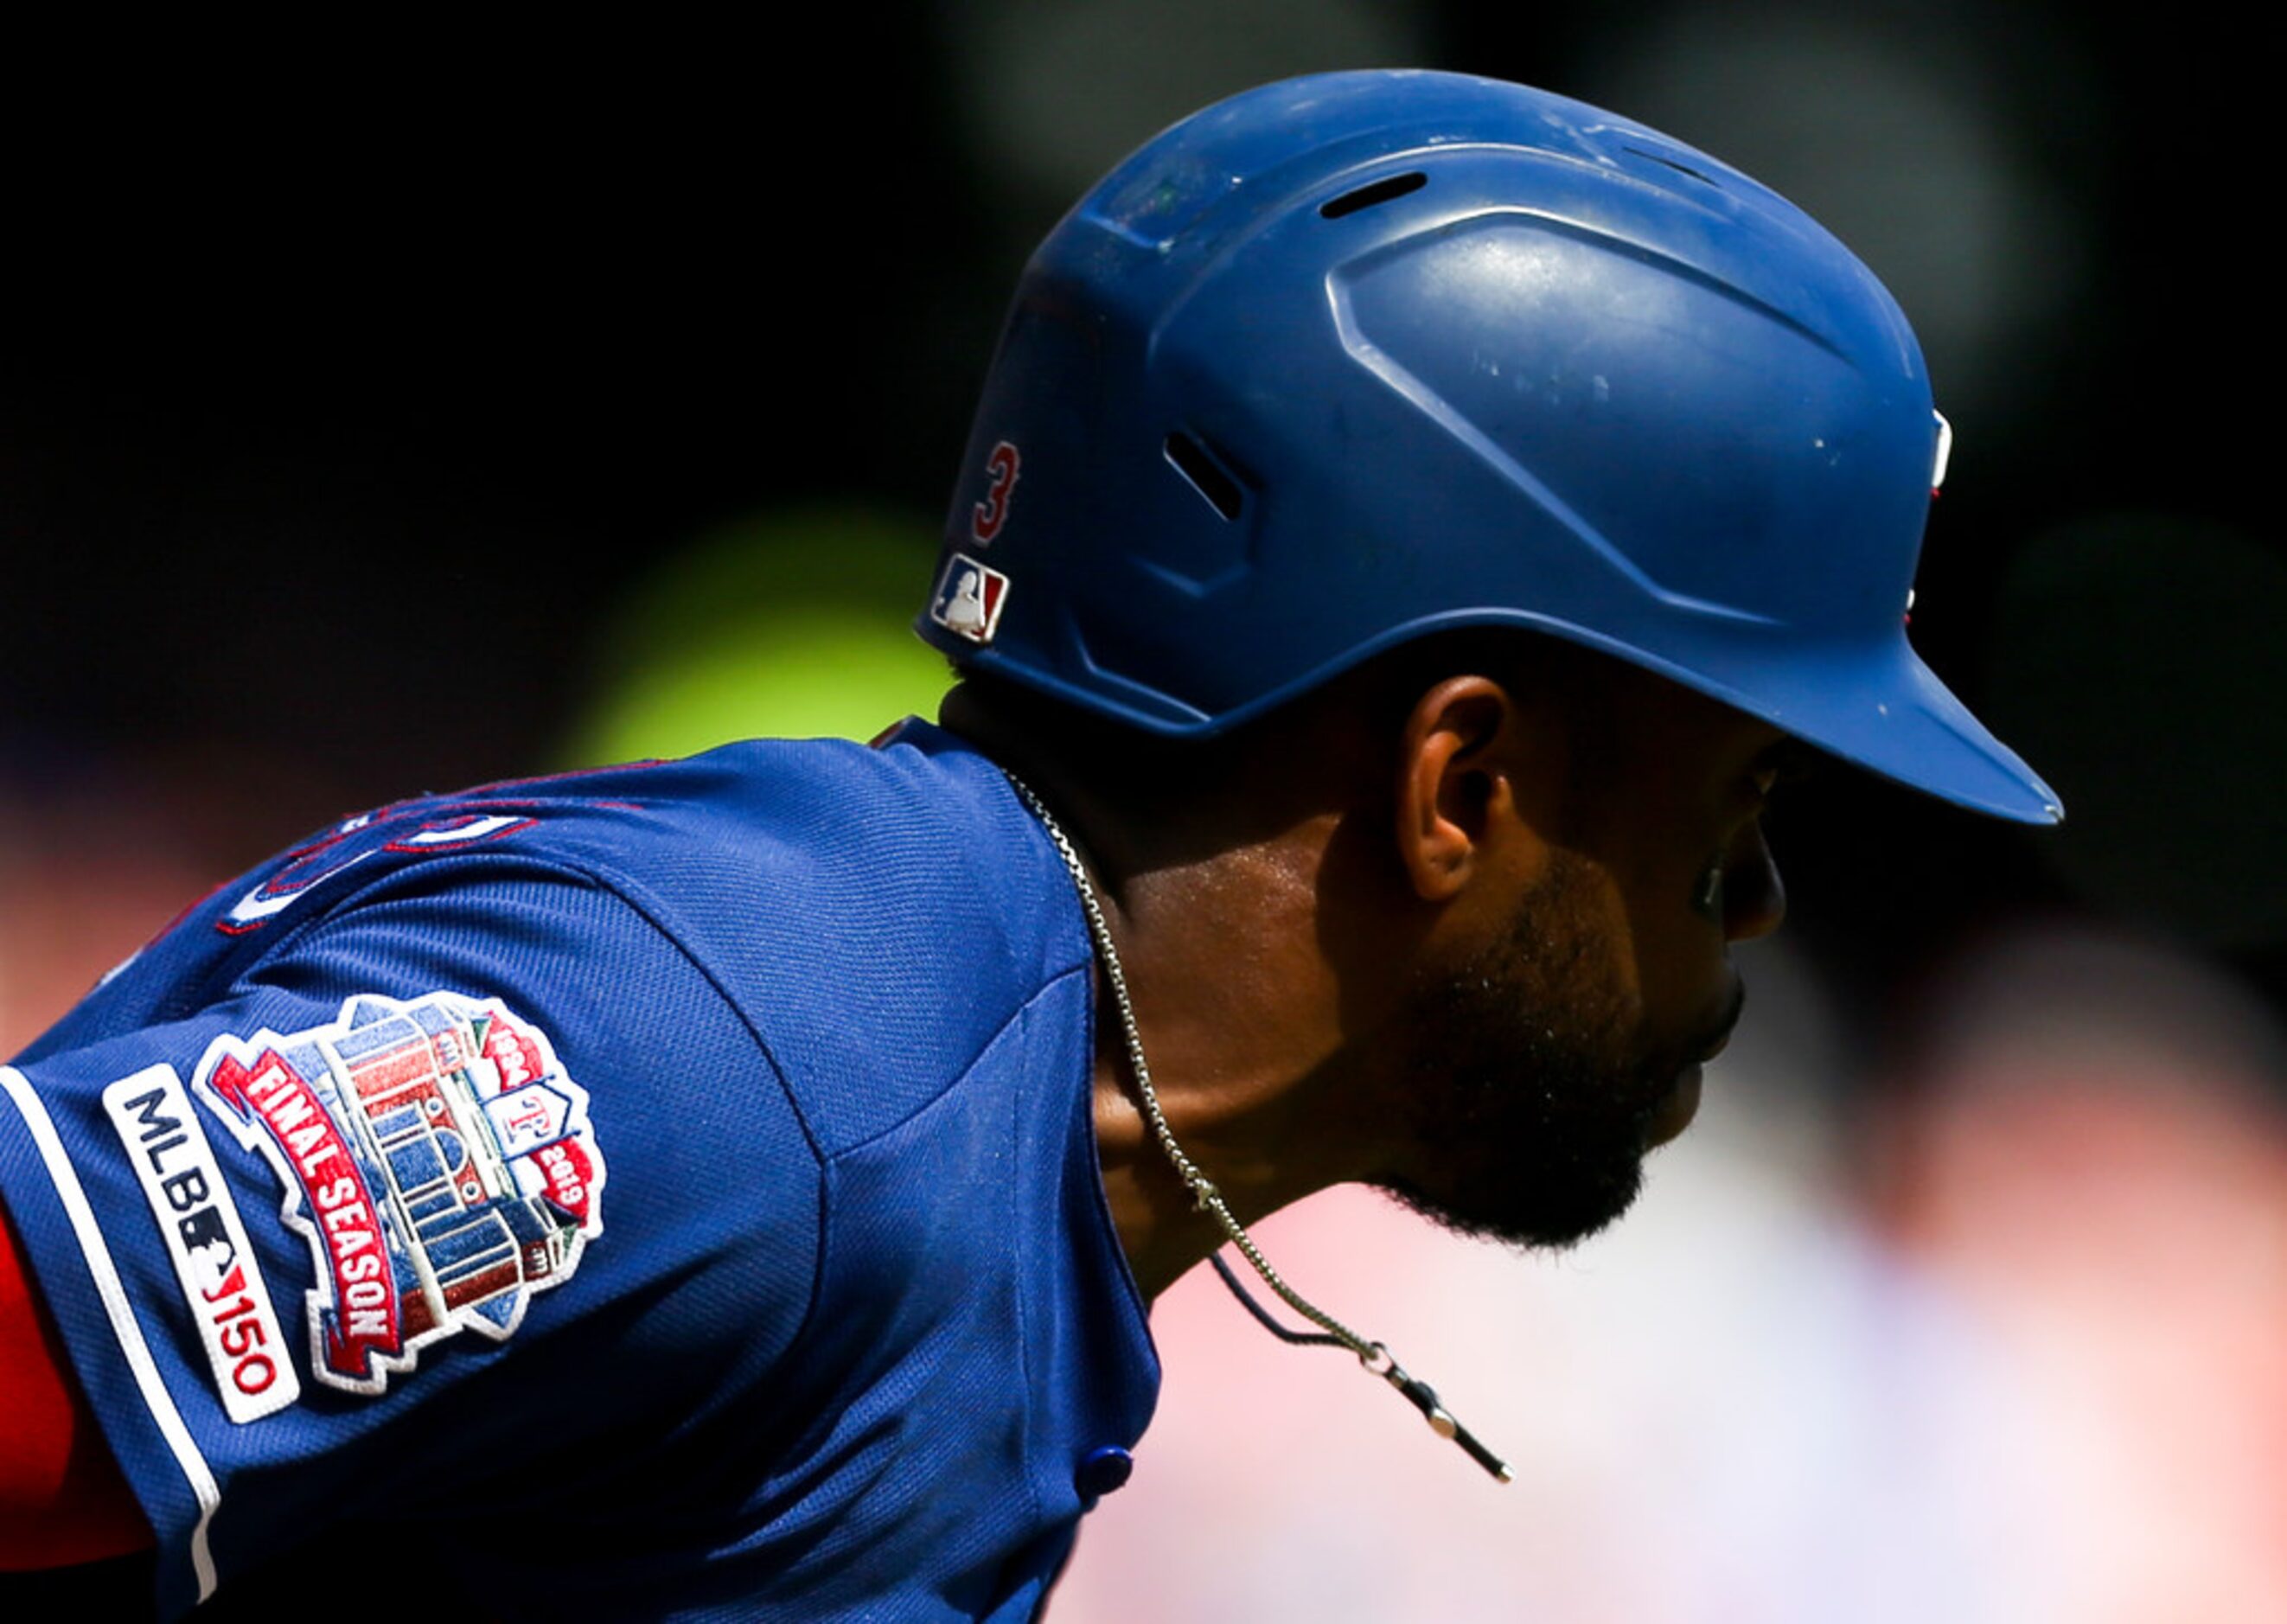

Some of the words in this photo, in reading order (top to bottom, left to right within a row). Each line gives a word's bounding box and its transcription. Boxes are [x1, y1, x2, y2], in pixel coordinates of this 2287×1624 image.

[972, 441, 1020, 547] 3
[124, 1087, 210, 1213] MLB
[214, 1296, 278, 1396] 150
[246, 1066, 339, 1179] FINAL
[318, 1177, 387, 1336] SEASON
[540, 1144, 583, 1205] 2019
